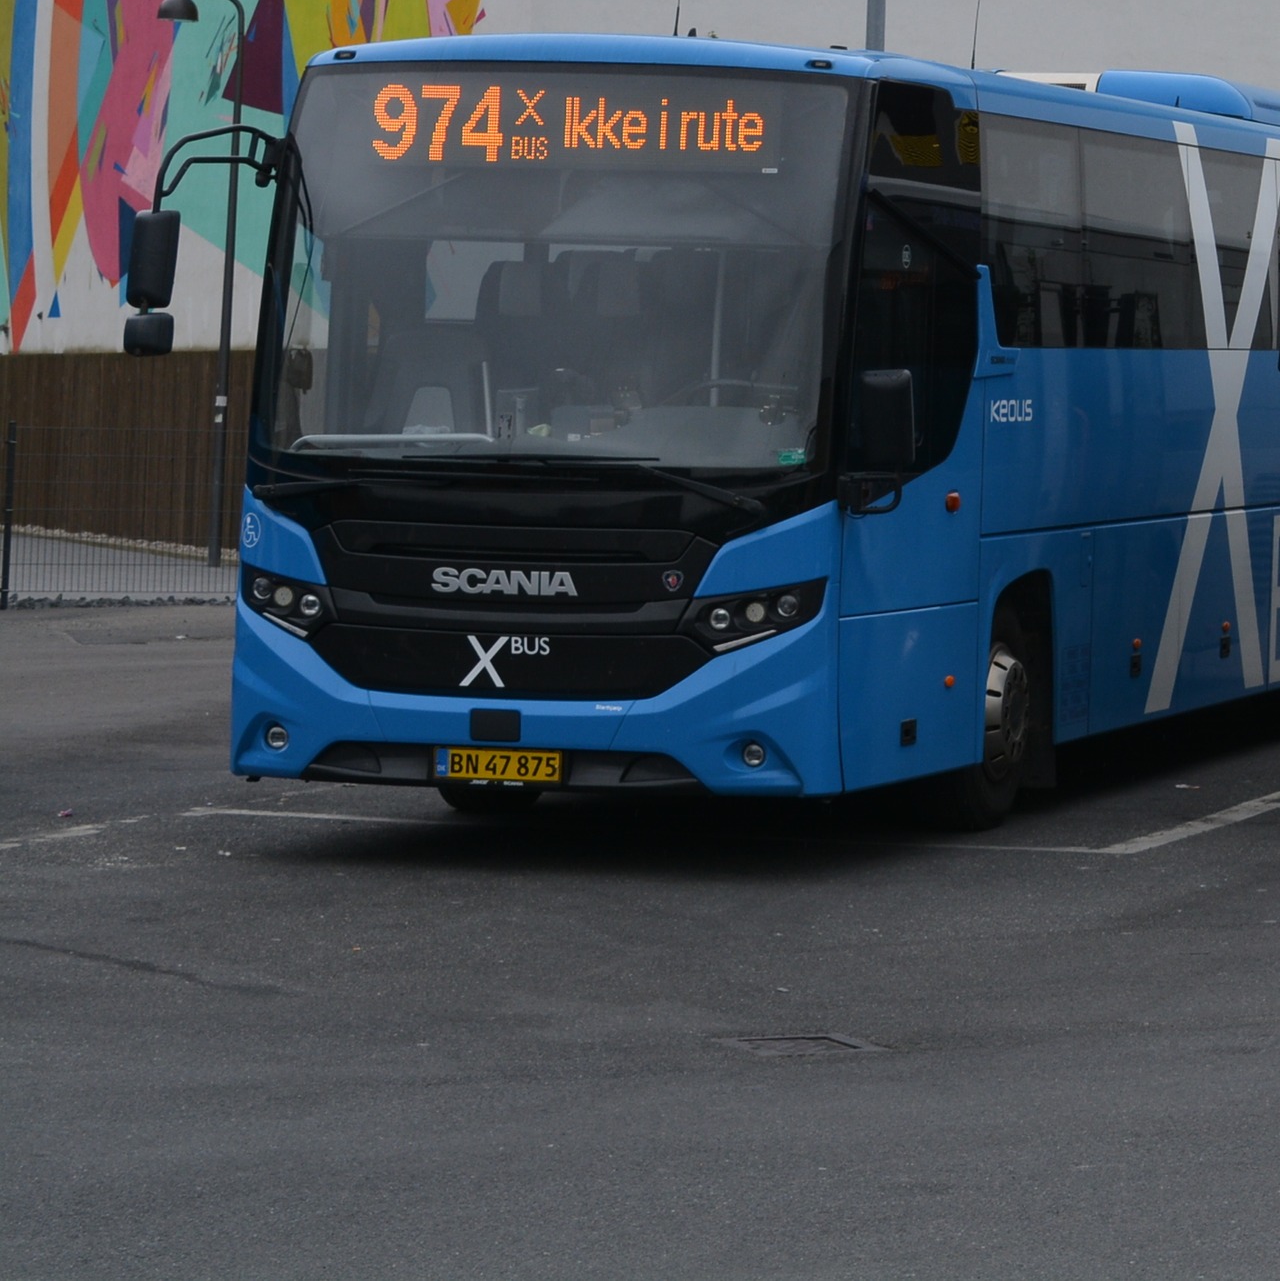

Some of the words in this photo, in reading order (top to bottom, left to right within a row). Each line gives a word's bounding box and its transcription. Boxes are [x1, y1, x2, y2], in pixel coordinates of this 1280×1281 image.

[373, 83, 504, 163] 974
[515, 89, 546, 126] X
[563, 96, 648, 150] Ikke
[658, 98, 669, 151] i
[679, 99, 765, 152] rute
[510, 136, 549, 160] BUS
[431, 566, 579, 597] SCANIA
[458, 634, 511, 688] X
[510, 636, 551, 656] BUS
[449, 753, 480, 775] BN
[484, 754, 512, 776] 47
[516, 755, 558, 778] 875
